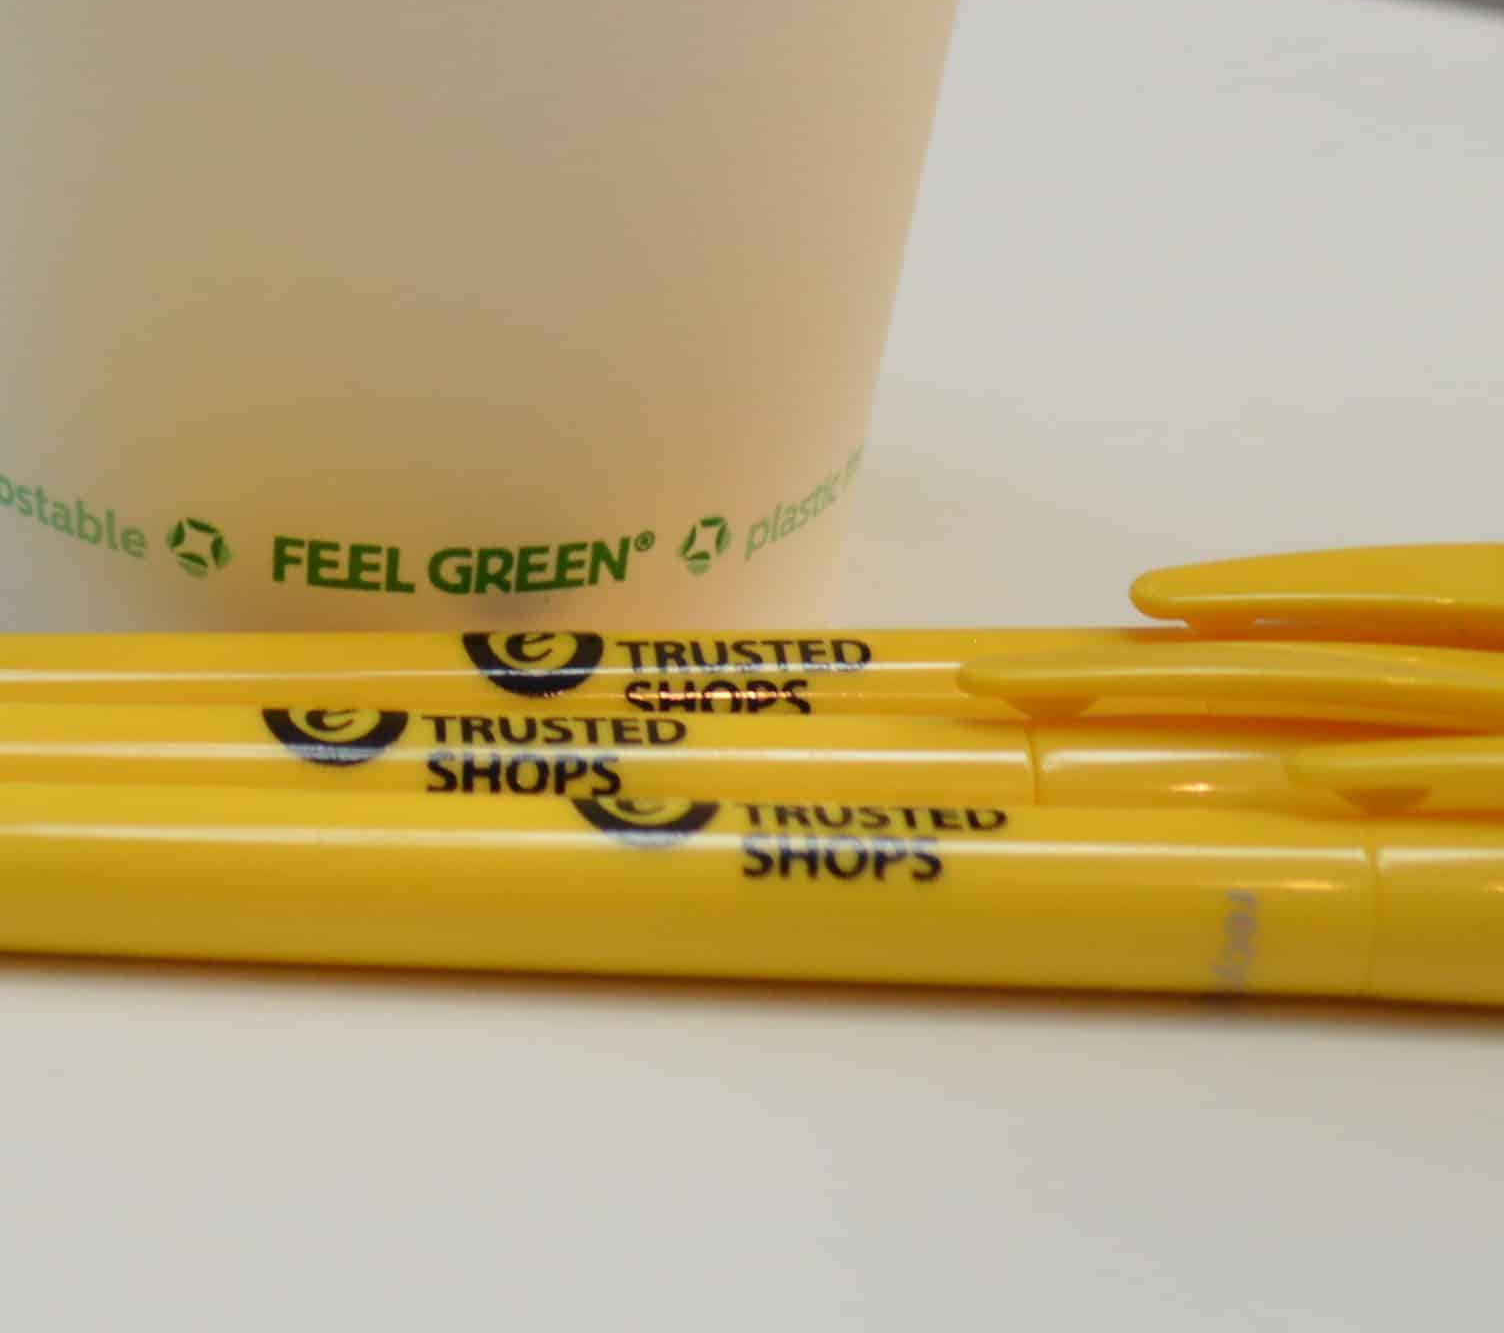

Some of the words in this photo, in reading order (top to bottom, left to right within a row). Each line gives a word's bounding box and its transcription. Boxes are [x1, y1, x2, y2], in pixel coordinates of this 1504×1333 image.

[271, 535, 417, 595] FEEL
[614, 639, 873, 675] TRUSTED
[421, 712, 689, 747] TRUSTED
[425, 751, 625, 797] SHOPS
[740, 834, 946, 883] SHOPS
